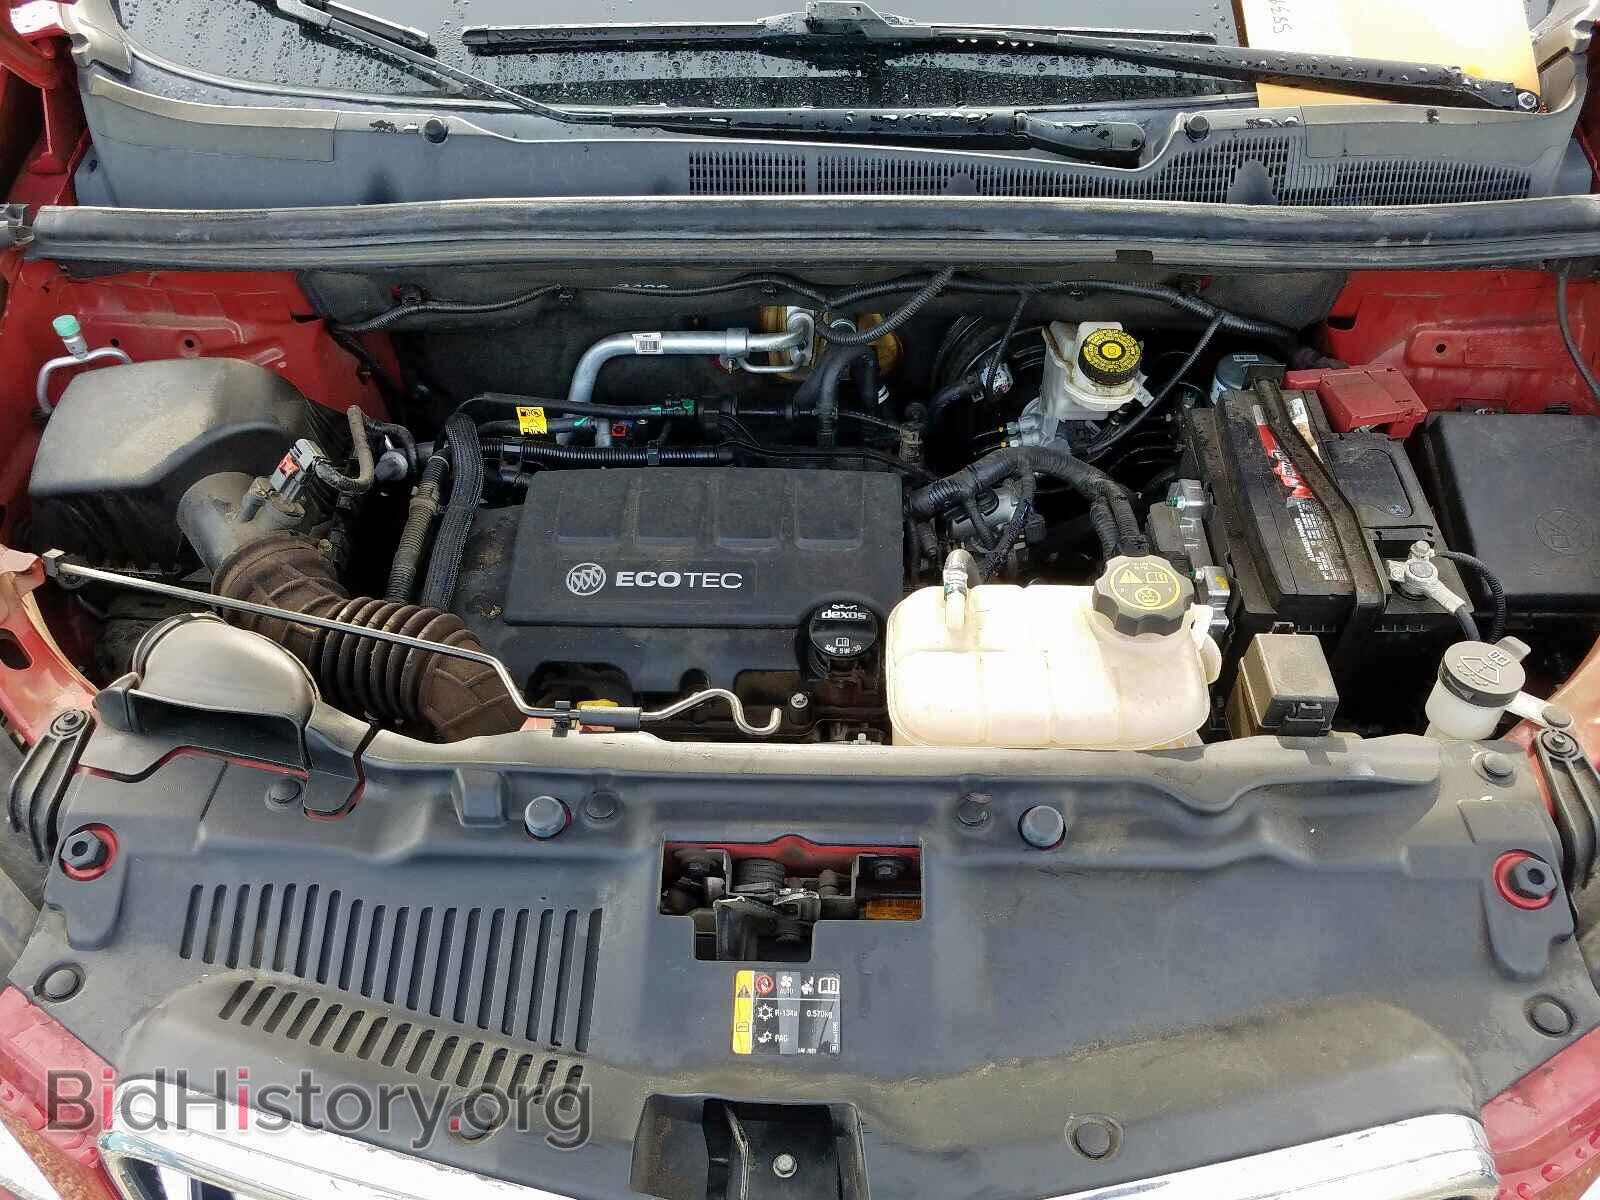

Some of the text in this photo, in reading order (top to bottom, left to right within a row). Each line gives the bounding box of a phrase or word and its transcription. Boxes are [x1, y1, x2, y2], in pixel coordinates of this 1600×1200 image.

[616, 571, 743, 589] ECOTEC
[822, 609, 866, 620] dexos
[825, 644, 837, 654] SAE
[774, 1009, 833, 1019] R-134a 0.570kg
[774, 1034, 788, 1042] PAG
